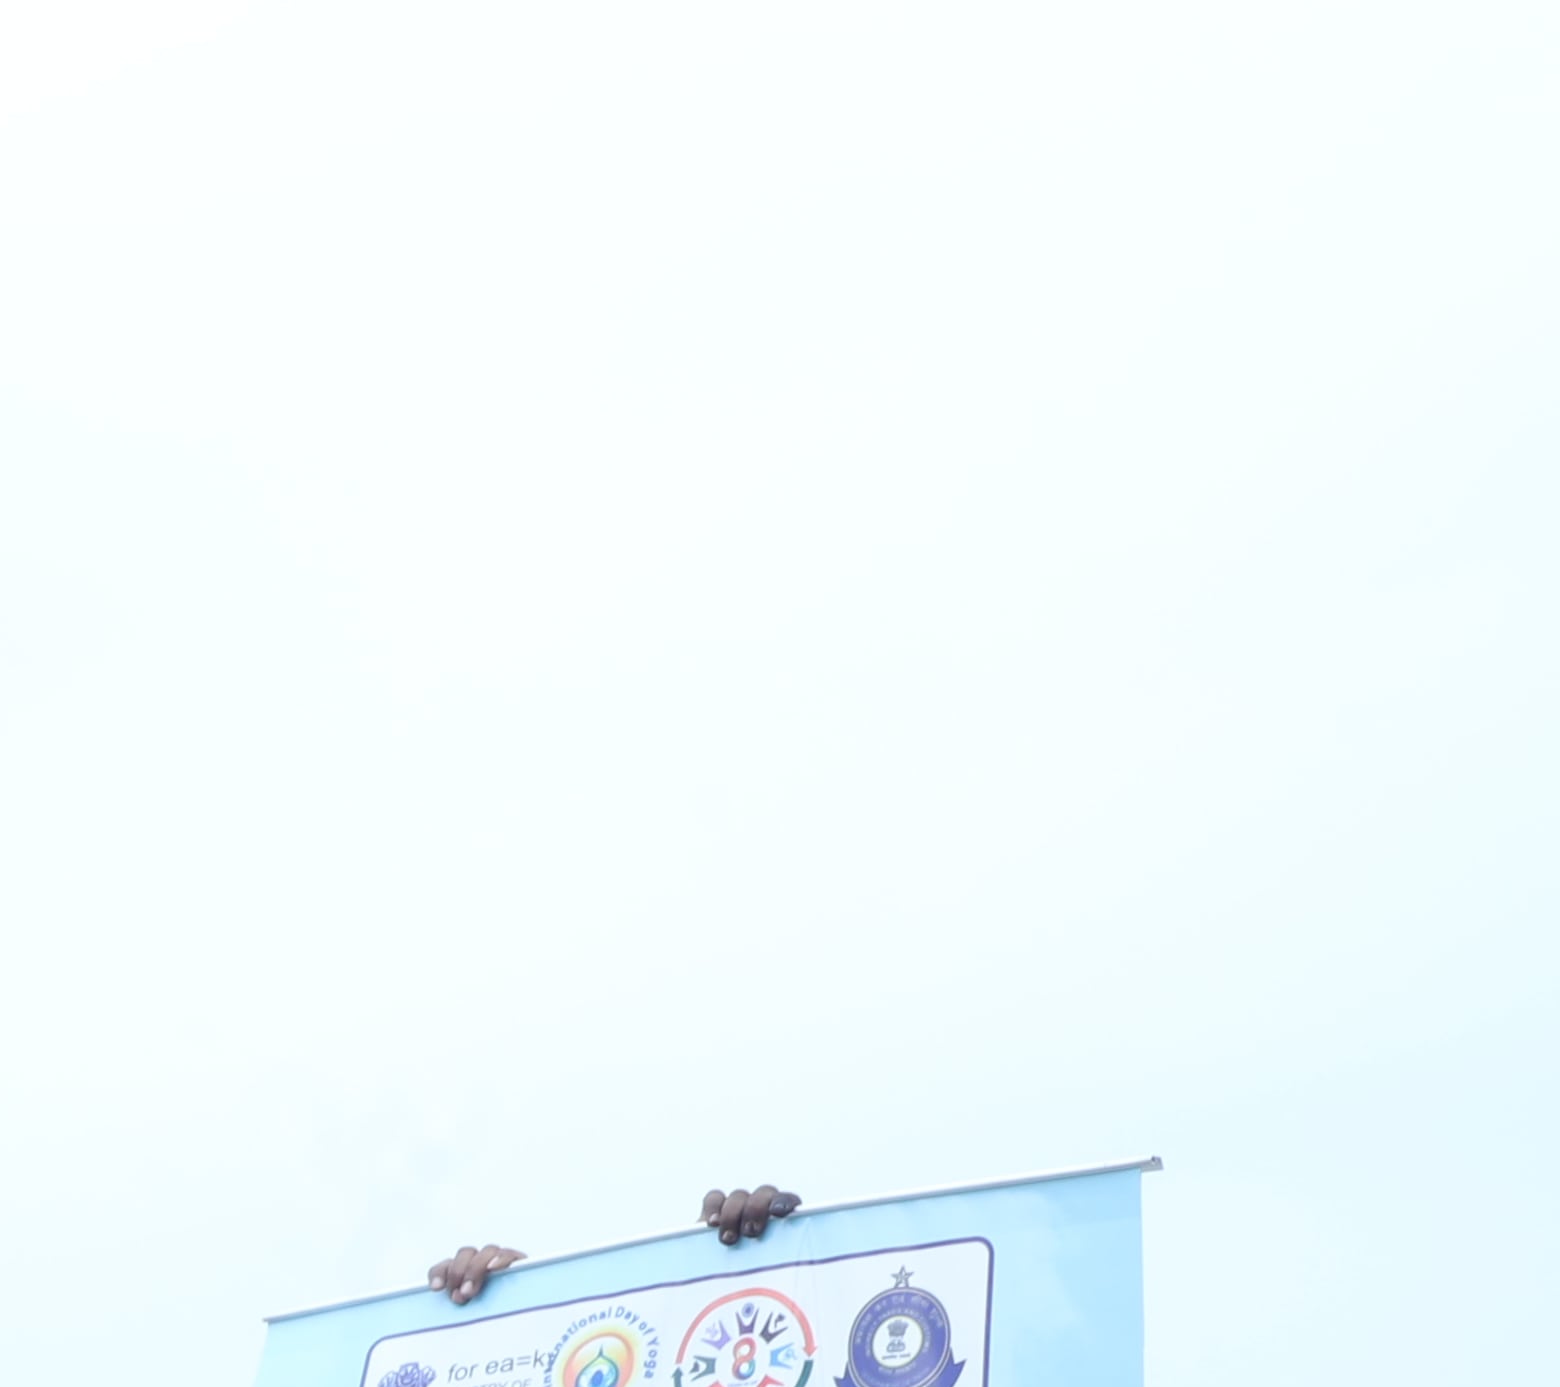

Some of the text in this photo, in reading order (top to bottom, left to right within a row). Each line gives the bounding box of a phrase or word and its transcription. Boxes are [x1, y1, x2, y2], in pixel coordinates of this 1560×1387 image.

[615, 1306, 640, 1325] Day
[638, 1321, 656, 1336] of
[644, 1336, 660, 1379] Yoga
[447, 1362, 478, 1383] for
